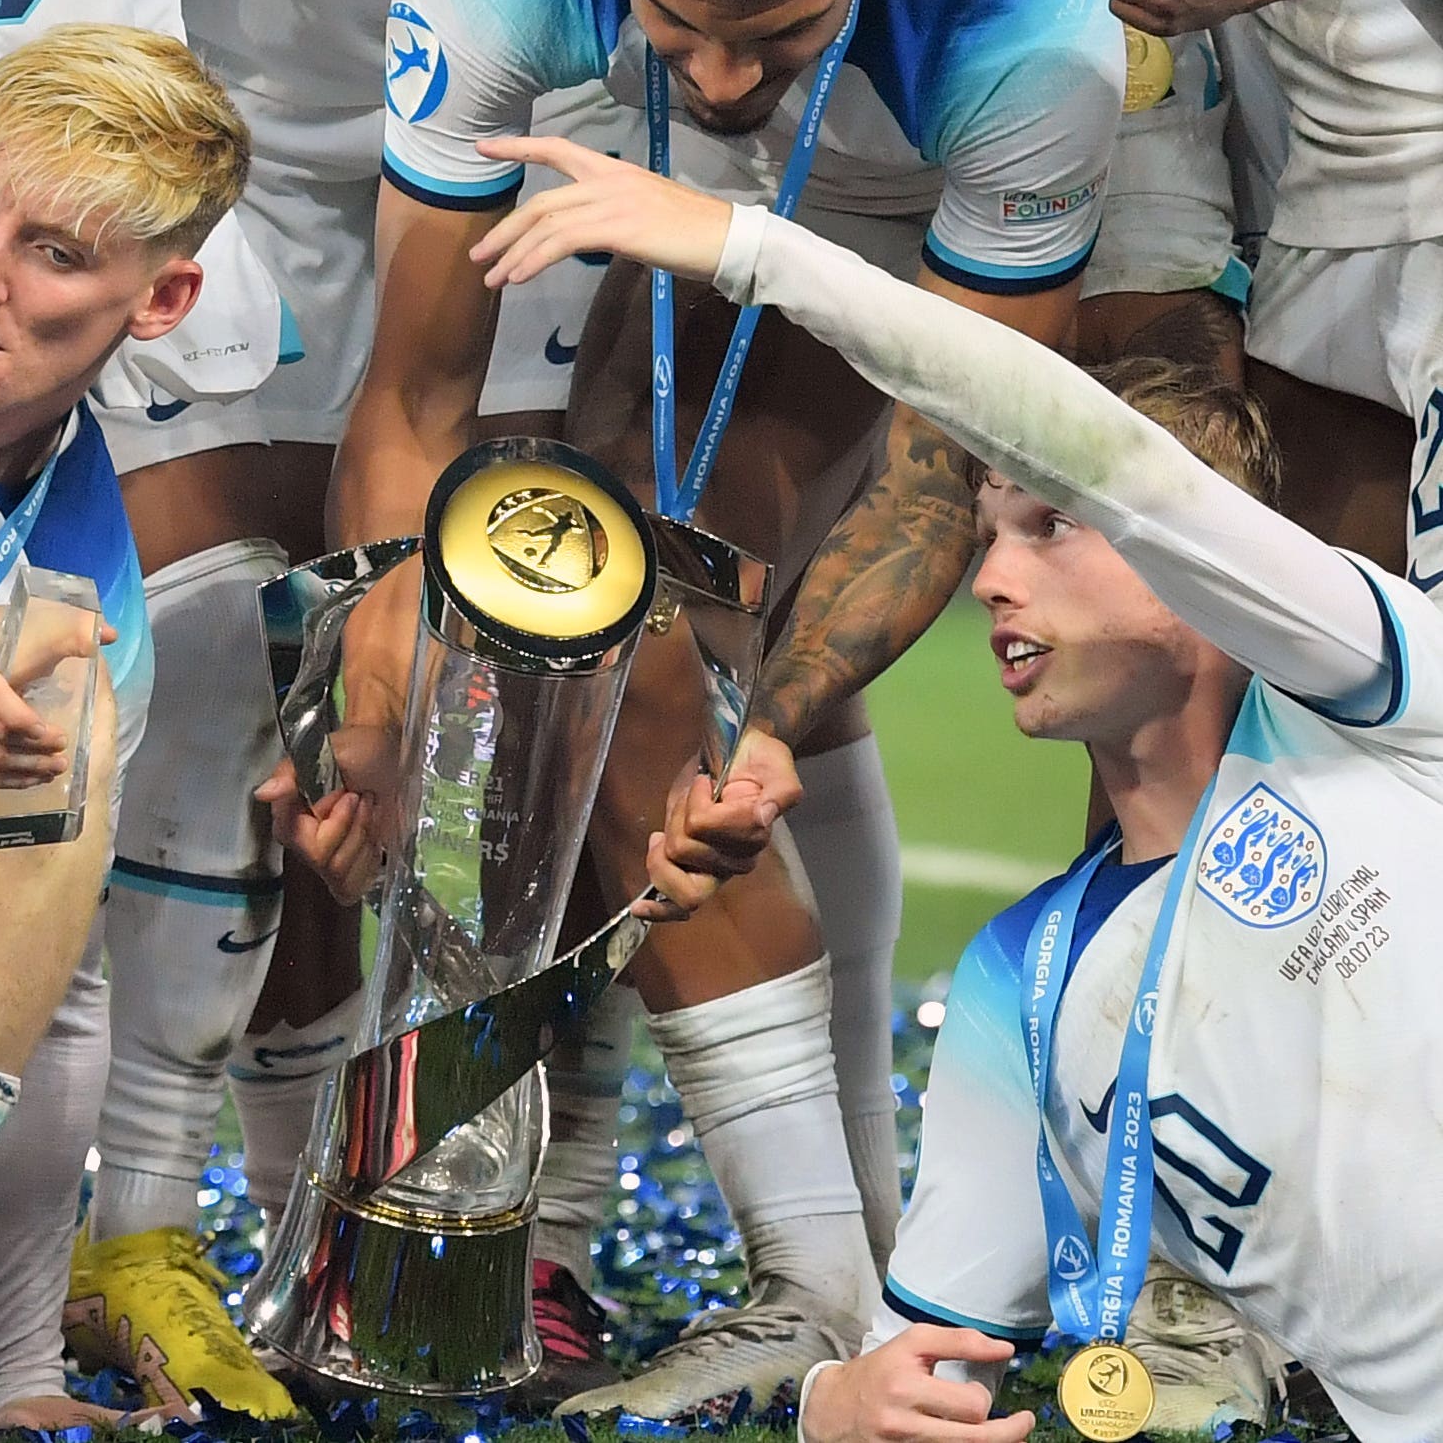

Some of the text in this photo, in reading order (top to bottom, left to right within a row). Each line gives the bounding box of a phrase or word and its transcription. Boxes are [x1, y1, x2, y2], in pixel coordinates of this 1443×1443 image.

[803, 59, 836, 148] GEORGIA
[693, 338, 747, 493] ROMANIA 2023
[1032, 910, 1063, 1002] GEORGIA
[1278, 864, 1380, 983] UEFA U21 EURO FINAL
[1305, 926, 1352, 990] ENGLAND
[1359, 888, 1392, 928] SPAIN
[1335, 924, 1391, 980] 08.07.23
[1100, 1091, 1142, 1339] ORGIA ROMANIA 2023
